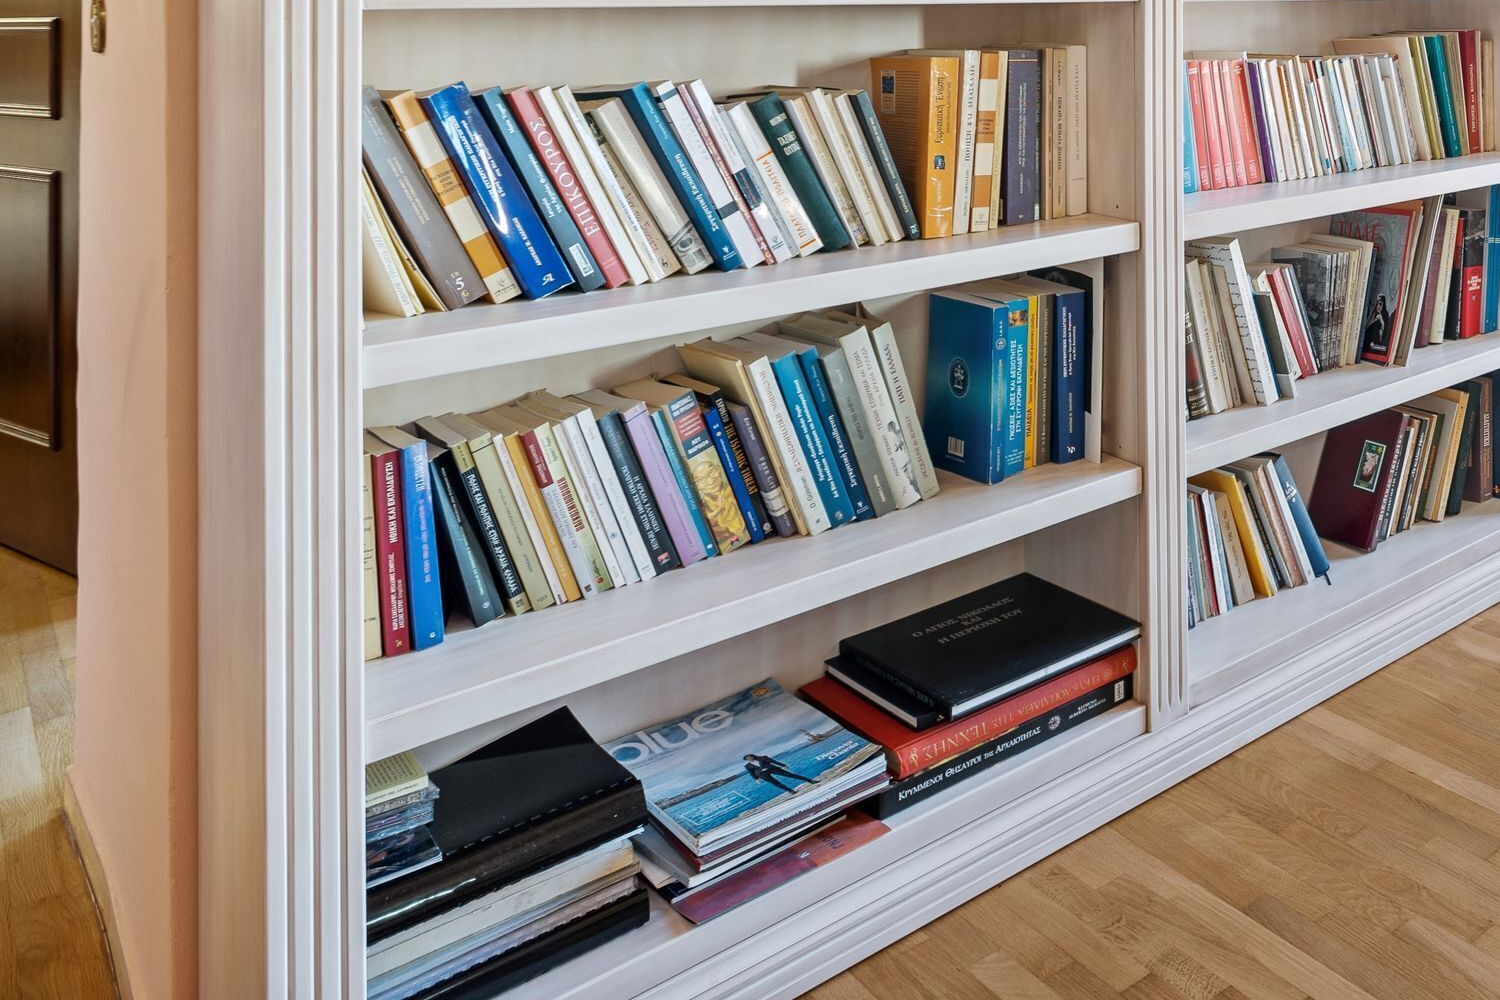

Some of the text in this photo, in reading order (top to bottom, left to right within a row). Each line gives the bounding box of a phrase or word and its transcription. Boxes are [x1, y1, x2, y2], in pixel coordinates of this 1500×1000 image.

[934, 77, 945, 144] Ευρωπαϊκή Ένωση
[529, 116, 600, 235] ΕΠΙΚΟΥΡΟΣ
[674, 153, 718, 232] Συγκριτική Εκπαίδευση
[762, 160, 785, 196] ΠΟΛΙΤΕΙΑ
[861, 347, 874, 370] ΕΛΛΑΔΑ
[715, 398, 732, 422] ESPOSITO
[893, 385, 907, 404] ΓΙΑΤΙ
[904, 415, 918, 439] ROMILLY
[723, 423, 758, 495] THE ISLAMIC THREAT
[828, 415, 858, 487] Συγκριτική Εκπαίδευση
[912, 446, 929, 479] JACQUELINE
[385, 461, 398, 543] ΗΘΙΚΗ ΚΑΙ ΕΚΠΑΙΔΕΥΣΗ
[950, 616, 999, 641] ΠΕΡΙΟΧΗ
[1001, 607, 1024, 624] ΤΟΥ
[828, 742, 859, 761] Chania
[898, 771, 943, 802] ΚΡΥΜΜΕΝΟΙ
[945, 753, 982, 781] ΘΗΣΑΥΡΟΙ
[995, 726, 1042, 759] ΑΡΧΑΙΟΤΗΤΑΣ
